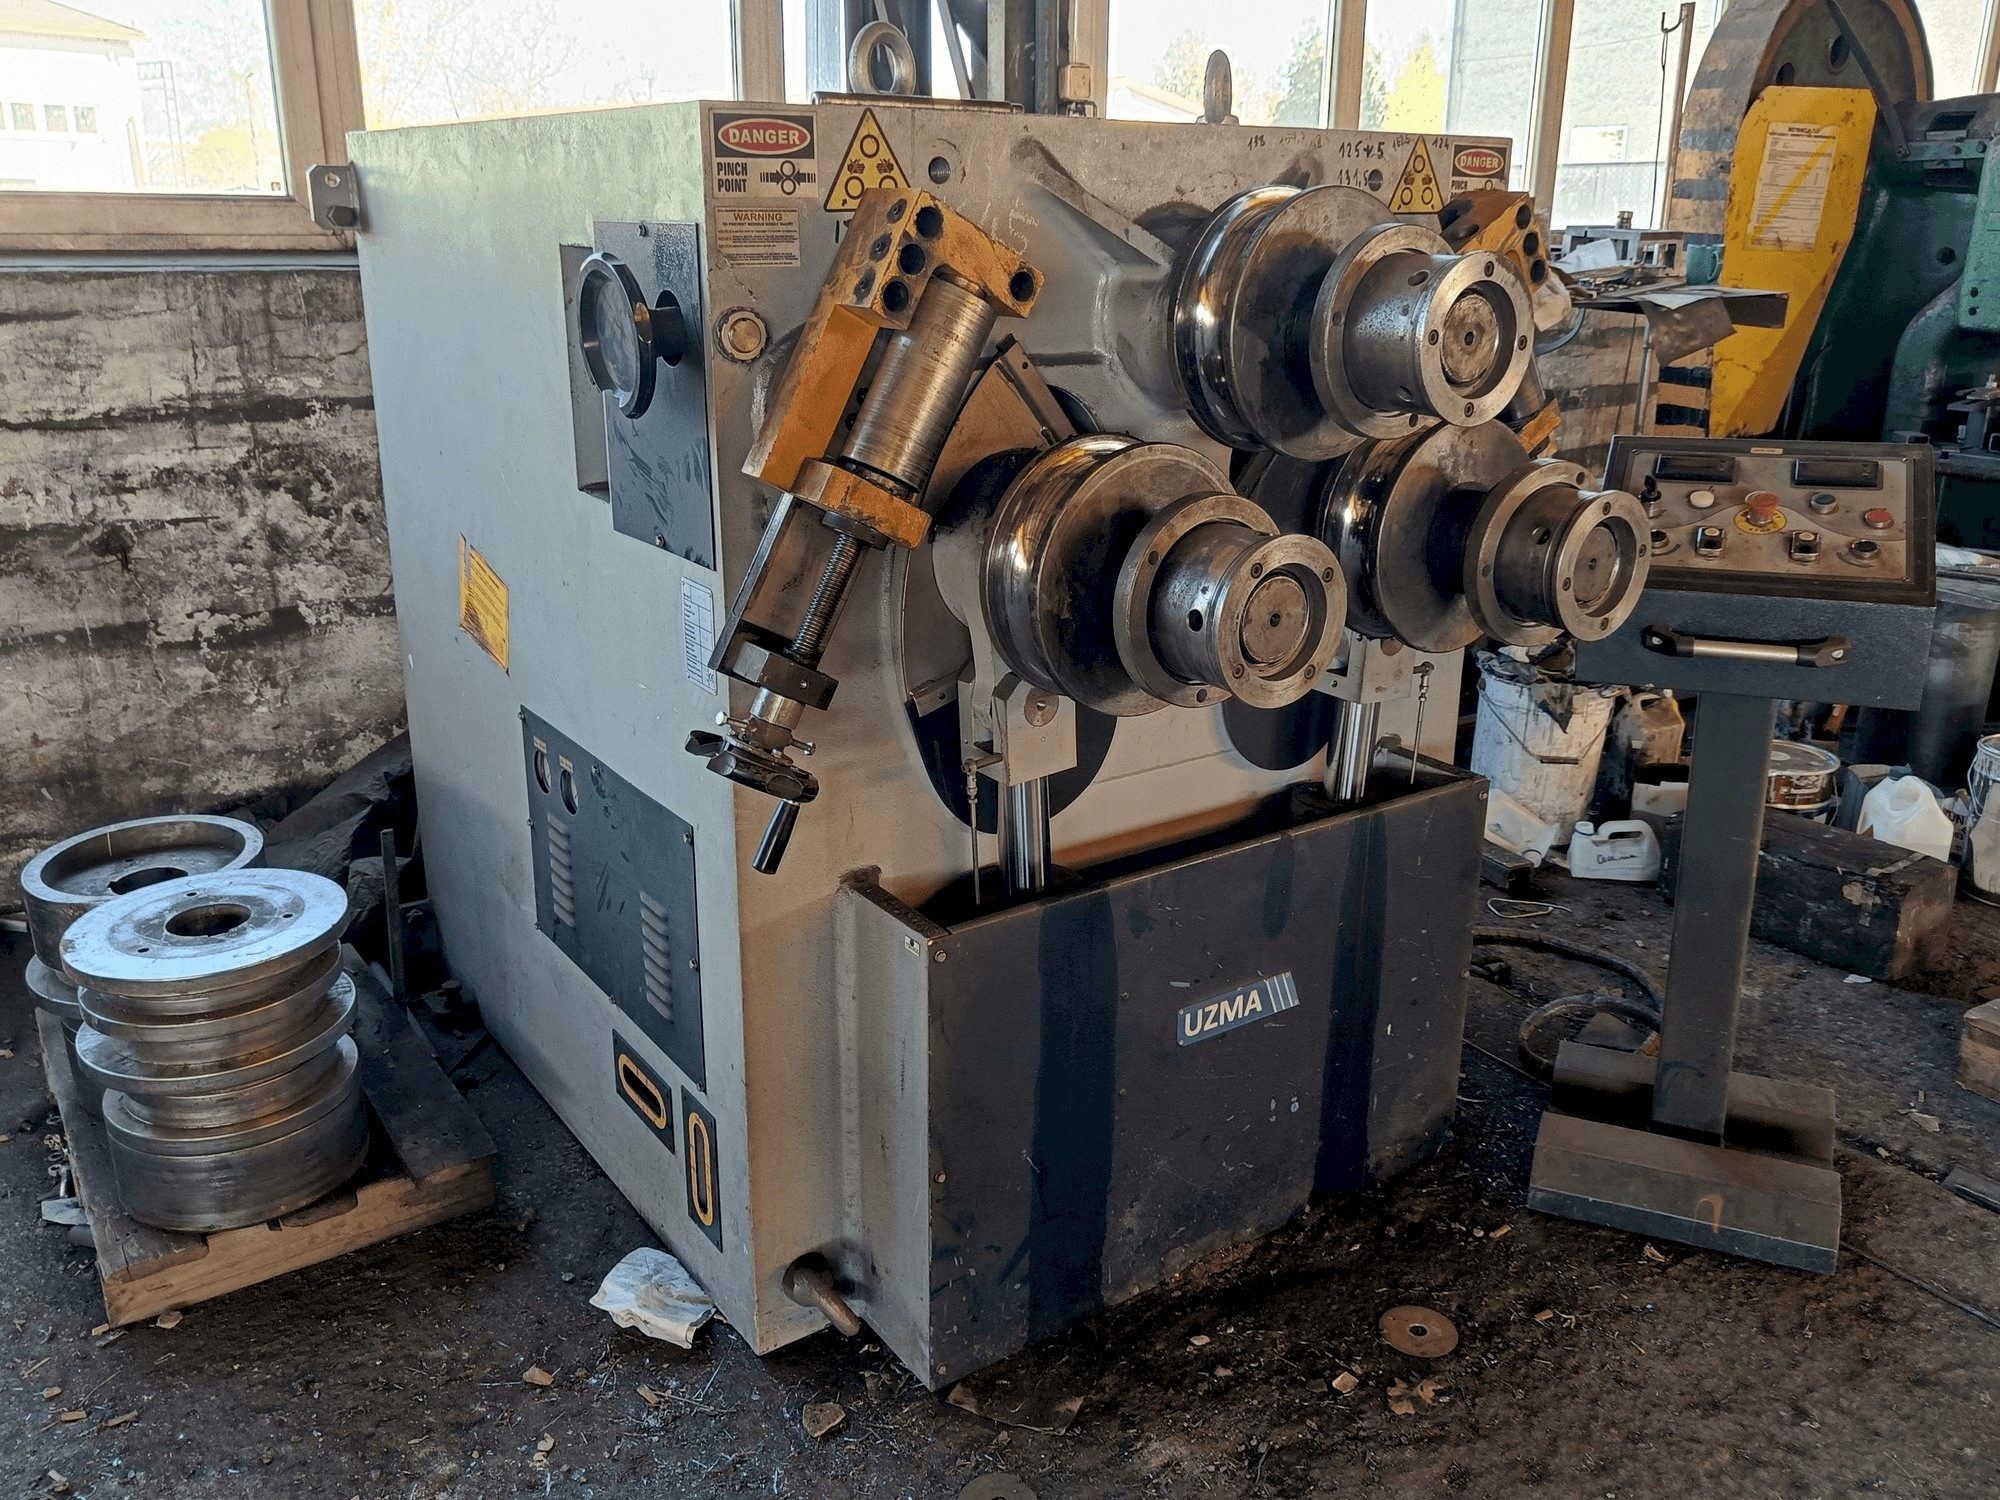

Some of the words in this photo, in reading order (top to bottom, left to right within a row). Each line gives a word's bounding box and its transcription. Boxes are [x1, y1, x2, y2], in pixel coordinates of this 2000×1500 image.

[729, 128, 800, 145] DANGER
[717, 162, 748, 176] PINCH
[1460, 155, 1499, 169] DANGER
[718, 178, 747, 192] POINT
[1451, 180, 1468, 190] PINCH
[733, 213, 783, 221] WARNING
[1184, 989, 1263, 1037] UZMA
